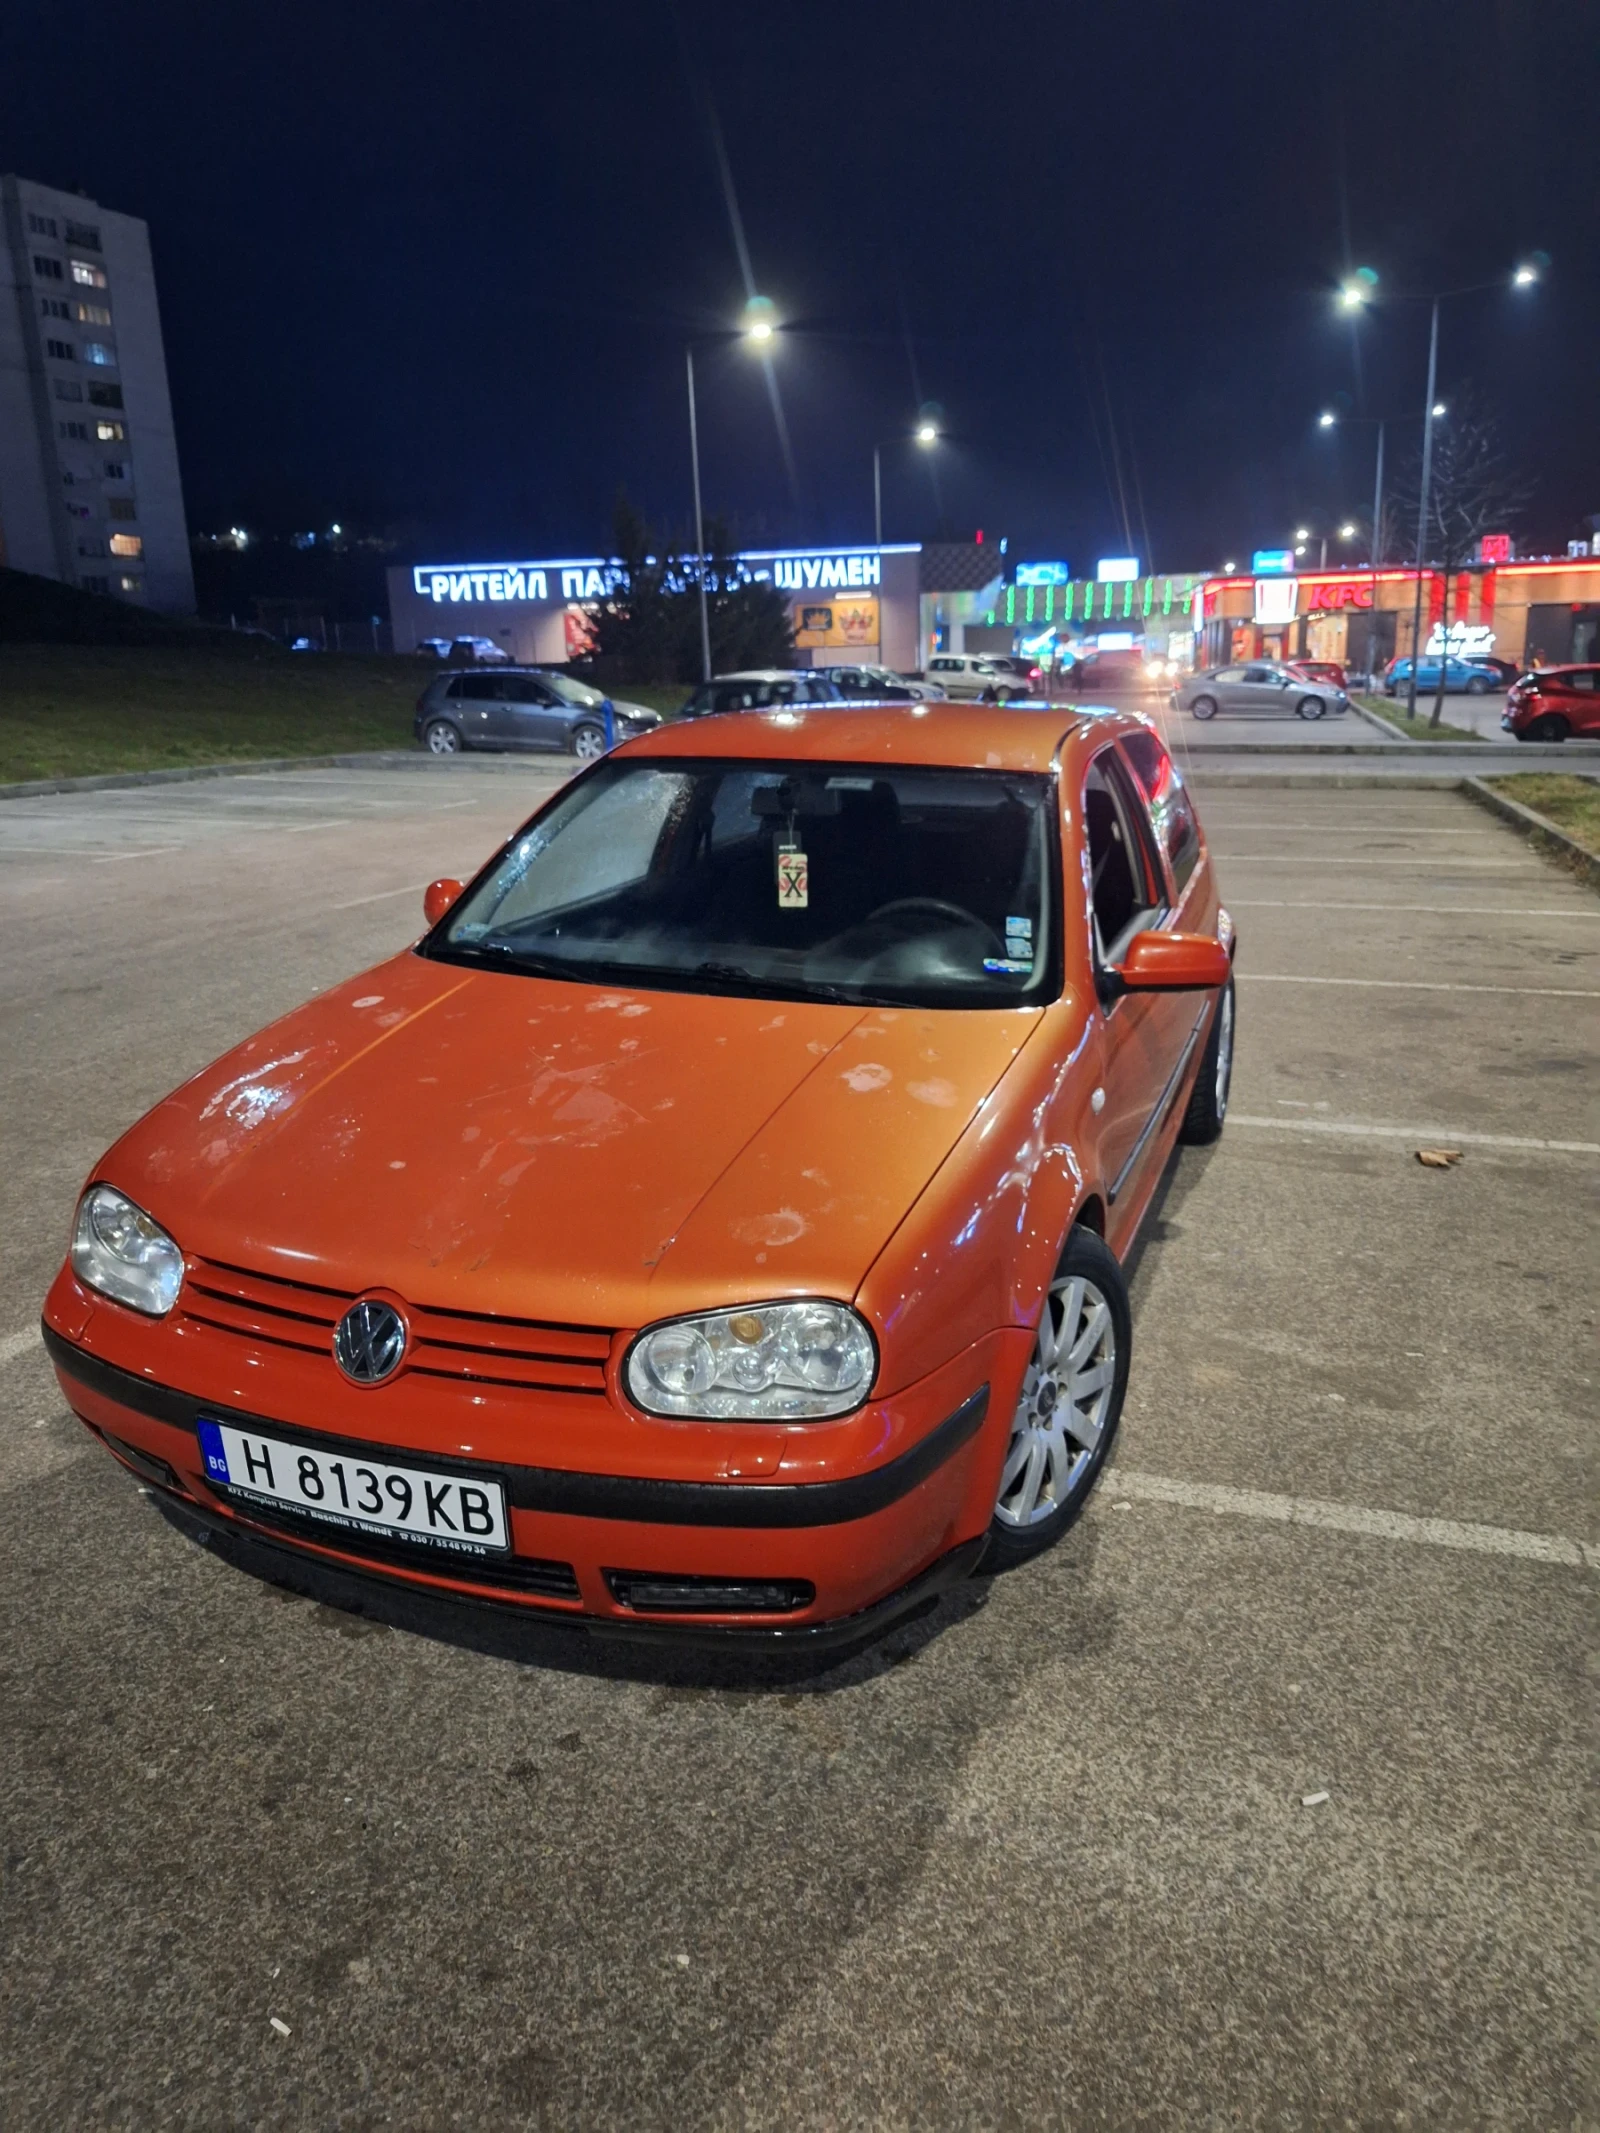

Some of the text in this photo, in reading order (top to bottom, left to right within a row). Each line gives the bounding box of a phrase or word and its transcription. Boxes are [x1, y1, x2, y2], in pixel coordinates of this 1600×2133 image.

[431, 567, 547, 602] РИТЕЙЛ
[1308, 583, 1374, 610] KFC
[208, 1455, 226, 1472] BG
[242, 1439, 275, 1489] H
[243, 1491, 277, 1506] Komplett
[278, 1502, 307, 1516] Service
[360, 1522, 393, 1537] Wendt
